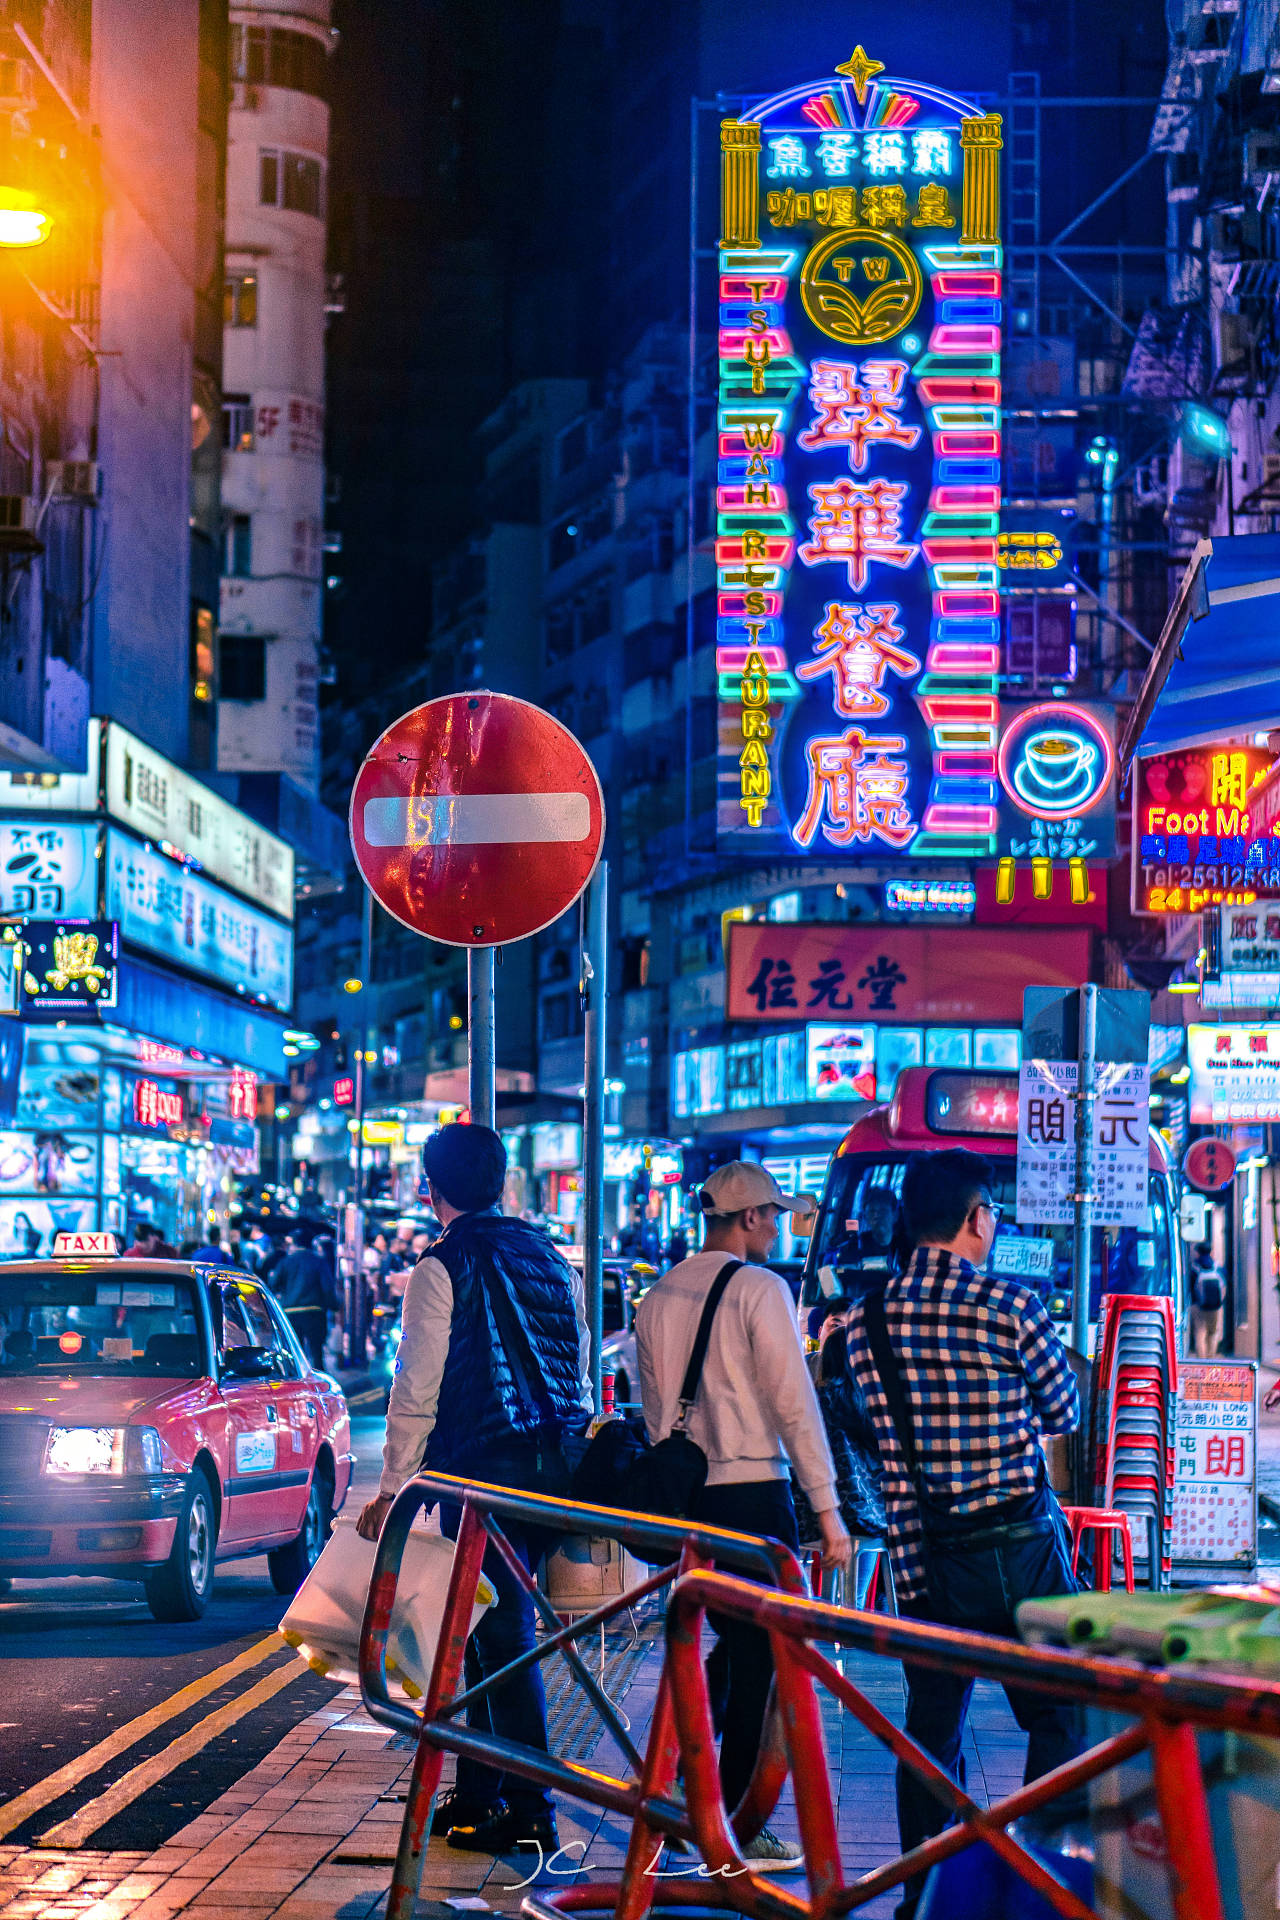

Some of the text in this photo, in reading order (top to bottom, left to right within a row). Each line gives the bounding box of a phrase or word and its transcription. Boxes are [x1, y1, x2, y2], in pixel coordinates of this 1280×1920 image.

[740, 281, 775, 828] TSUI WAH RESTAURANT
[794, 357, 921, 849] 翠華餐廳
[1148, 808, 1209, 835] Foot
[1147, 886, 1183, 912] 24
[60, 1237, 110, 1250] TAXI
[1223, 1404, 1248, 1413] LONG
[1179, 1435, 1197, 1476] 屯門
